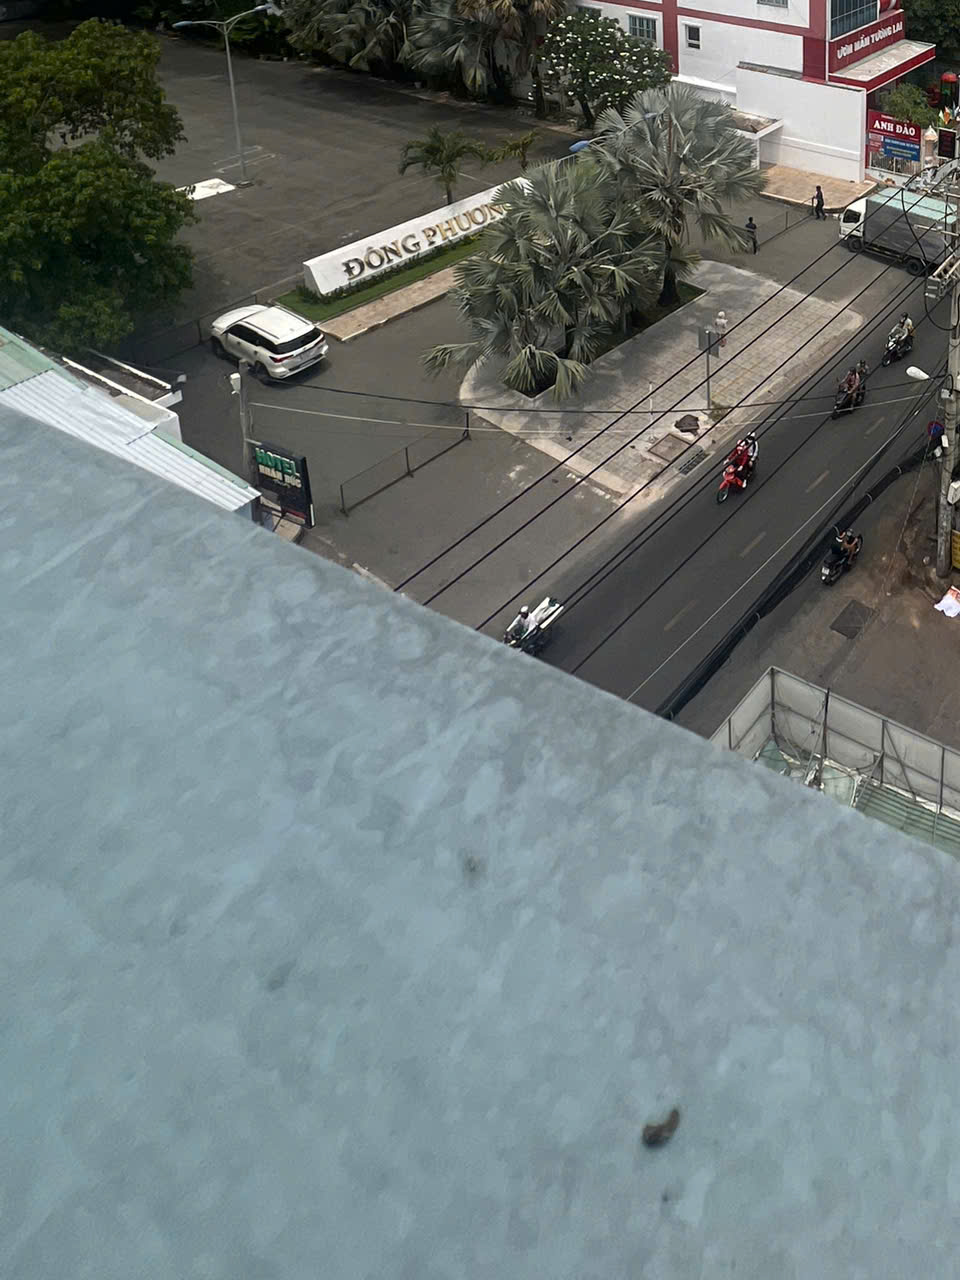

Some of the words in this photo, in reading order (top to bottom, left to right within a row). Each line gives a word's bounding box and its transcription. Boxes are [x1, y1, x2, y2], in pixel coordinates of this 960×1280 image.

[892, 21, 903, 34] LAI
[873, 120, 894, 132] ANH
[895, 123, 916, 137] ĐÀO
[341, 233, 421, 281] ĐÔNG
[255, 447, 300, 477] HOTEL
